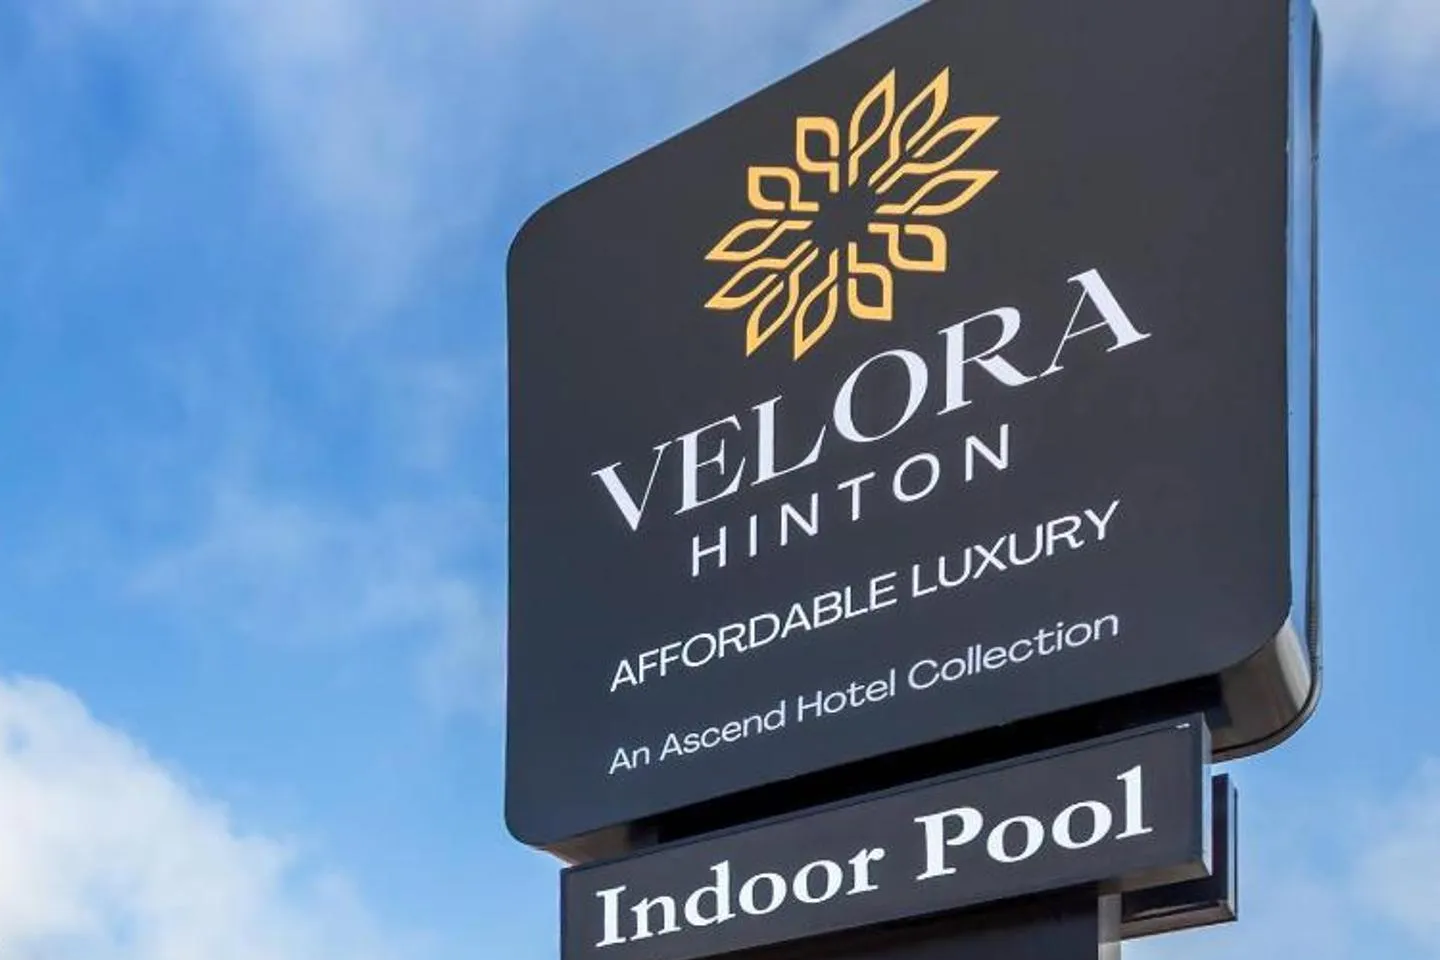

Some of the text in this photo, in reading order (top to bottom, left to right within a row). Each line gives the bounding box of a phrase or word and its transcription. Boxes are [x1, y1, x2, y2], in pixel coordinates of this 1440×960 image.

[591, 267, 1152, 532] VELORA
[690, 423, 1010, 578] HINTON
[609, 499, 1121, 693] AFFORDABLE LUXURY
[608, 613, 1120, 775] An Ascend Hotel Collection
[595, 764, 1154, 948] Indoor Pool
